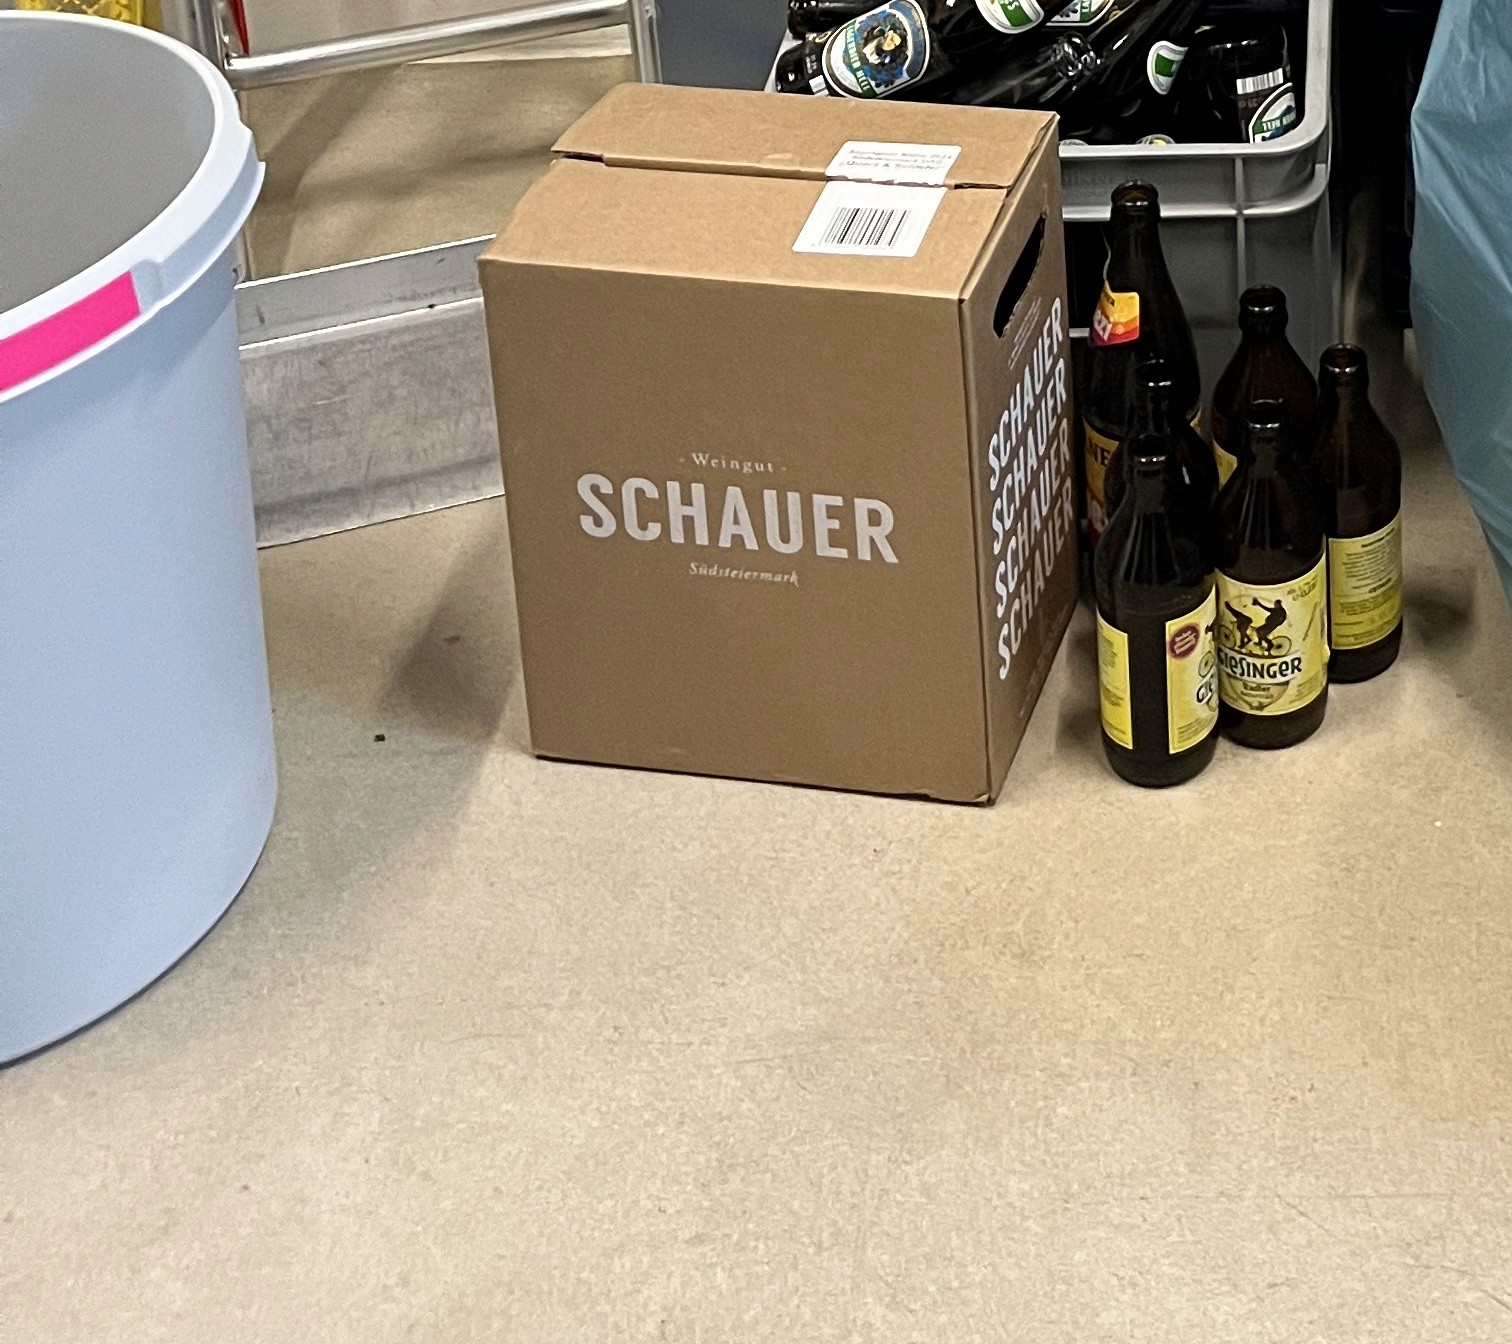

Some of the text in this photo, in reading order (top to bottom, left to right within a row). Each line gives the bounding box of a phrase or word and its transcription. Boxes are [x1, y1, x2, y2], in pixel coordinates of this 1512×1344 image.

[692, 452, 773, 474] Weingut
[988, 297, 1064, 491] SCHAUER
[992, 357, 1066, 555] SCHAUER
[577, 473, 899, 564] SCHAUER
[689, 562, 800, 586] Südsteiermark
[997, 417, 1071, 618] SCHAUER
[998, 477, 1074, 680] SCHAUER
